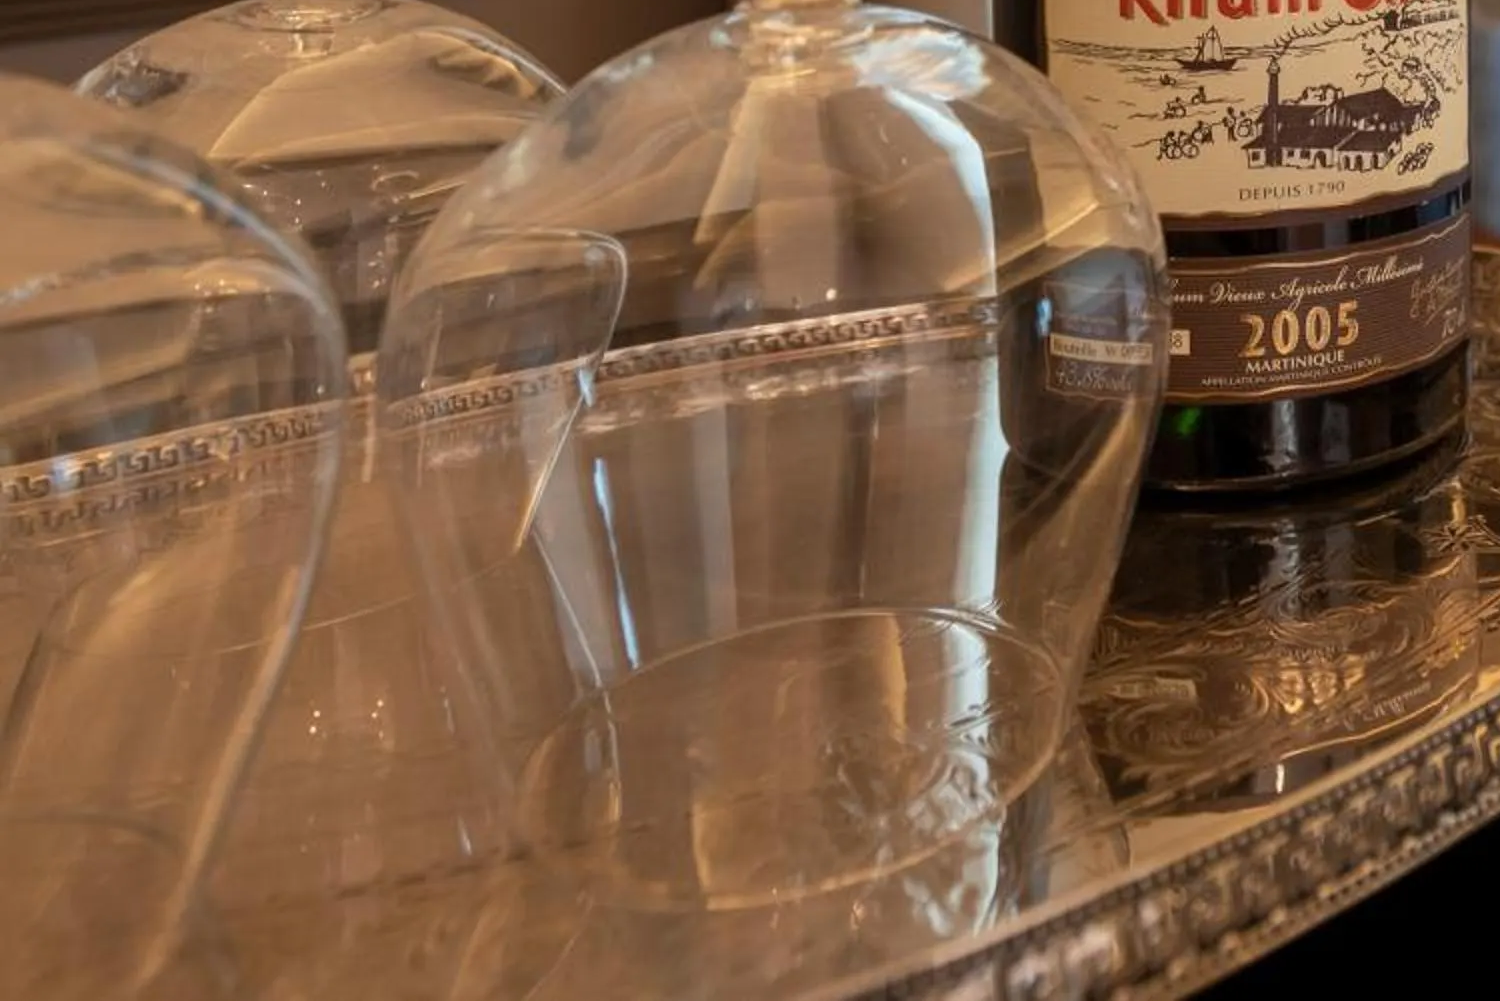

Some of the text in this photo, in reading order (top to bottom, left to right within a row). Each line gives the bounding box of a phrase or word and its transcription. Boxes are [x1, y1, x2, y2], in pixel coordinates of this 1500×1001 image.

[1238, 179, 1346, 201] DEPUIS 1790
[1270, 263, 1348, 311] Agricole
[1237, 299, 1360, 358] 2005
[1245, 349, 1345, 374] MARTINIQUE
